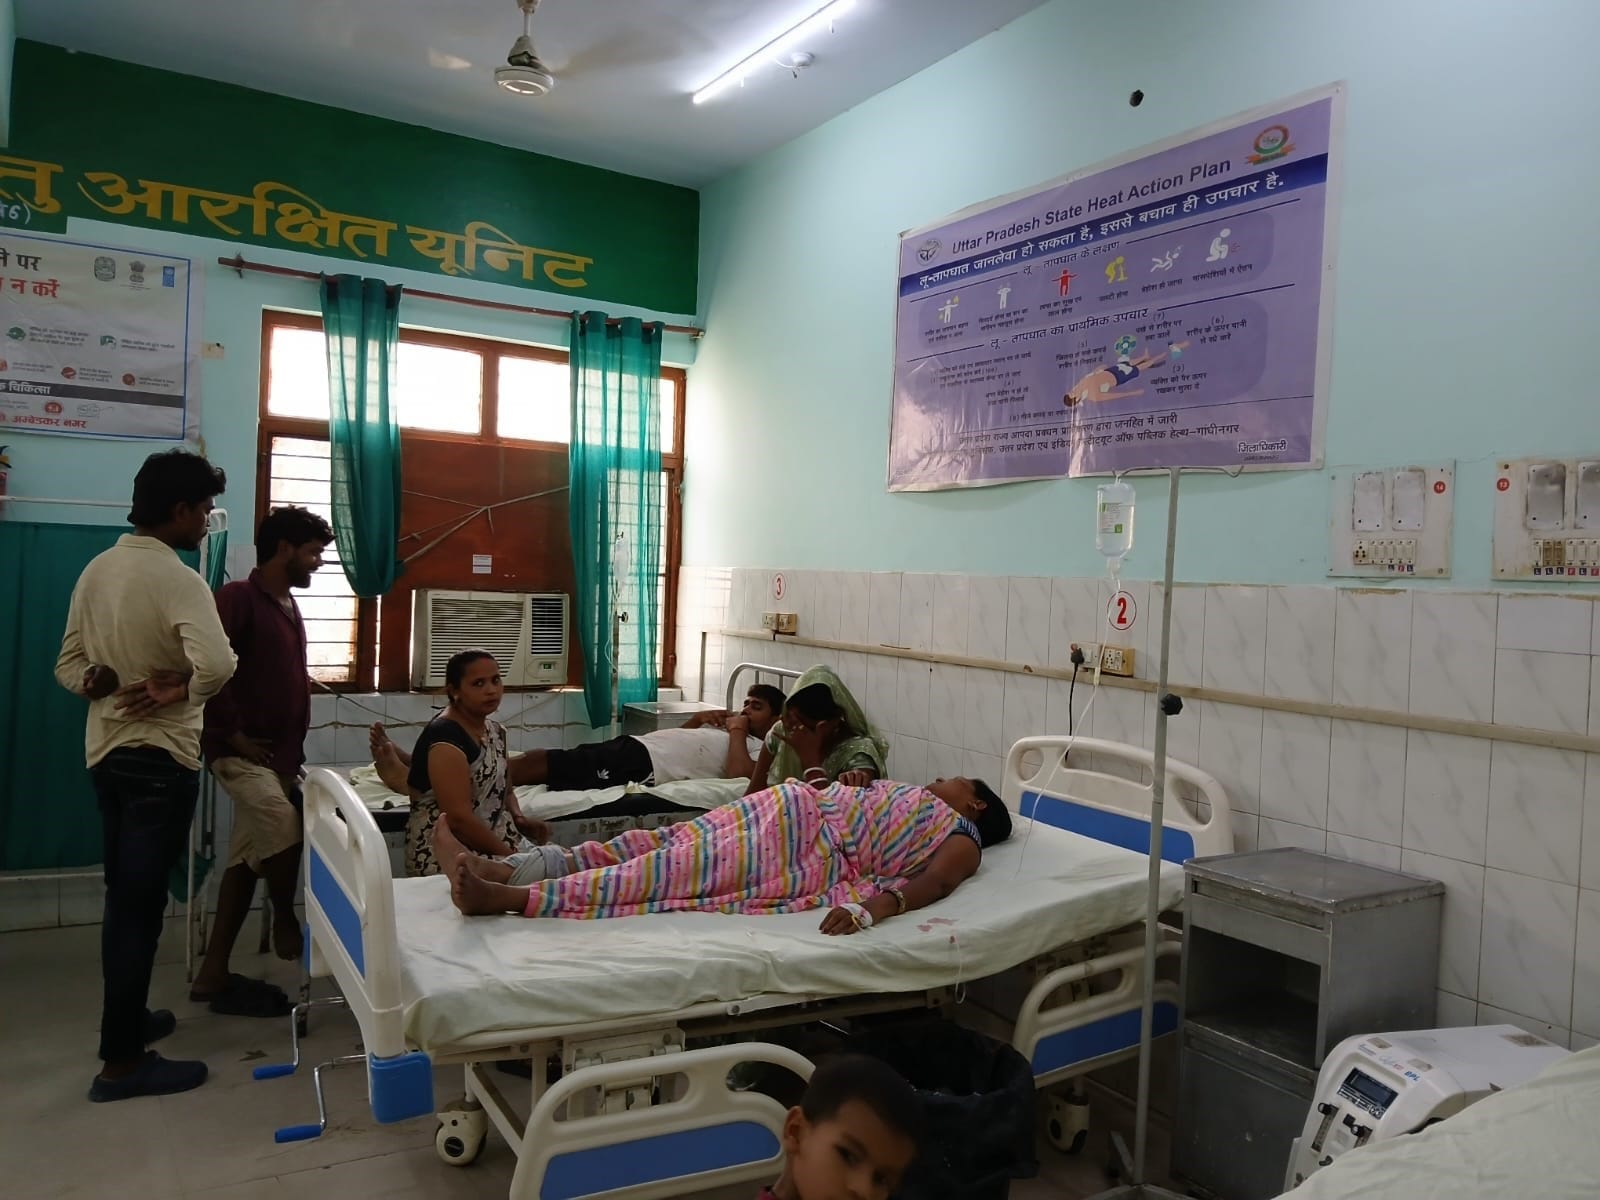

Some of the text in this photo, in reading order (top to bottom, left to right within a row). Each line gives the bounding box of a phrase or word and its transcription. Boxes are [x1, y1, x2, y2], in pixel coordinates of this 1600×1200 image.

[952, 159, 1231, 254] Uttar Pradesh State Heat Action Plan
[78, 171, 398, 258] आरक्षित
[405, 221, 594, 288] यूनिट
[973, 247, 1017, 270] जानलेवा
[1022, 239, 1034, 258] हो
[1038, 231, 1077, 252] सकता
[1099, 213, 1134, 236] इससे
[1139, 202, 1177, 223] बचाव
[1183, 193, 1199, 213] ही
[1205, 179, 1260, 205] उपचार
[16, 254, 42, 271] पर
[10, 278, 26, 294] न
[1011, 328, 1046, 344] तापघात
[1051, 325, 1064, 335] का
[9, 380, 52, 395] चिकित्सा
[1115, 415, 1144, 428] जनहित
[1157, 411, 1178, 425] जारी
[1238, 439, 1287, 454] जिलाधिकारी
[1116, 597, 1127, 624] 2
